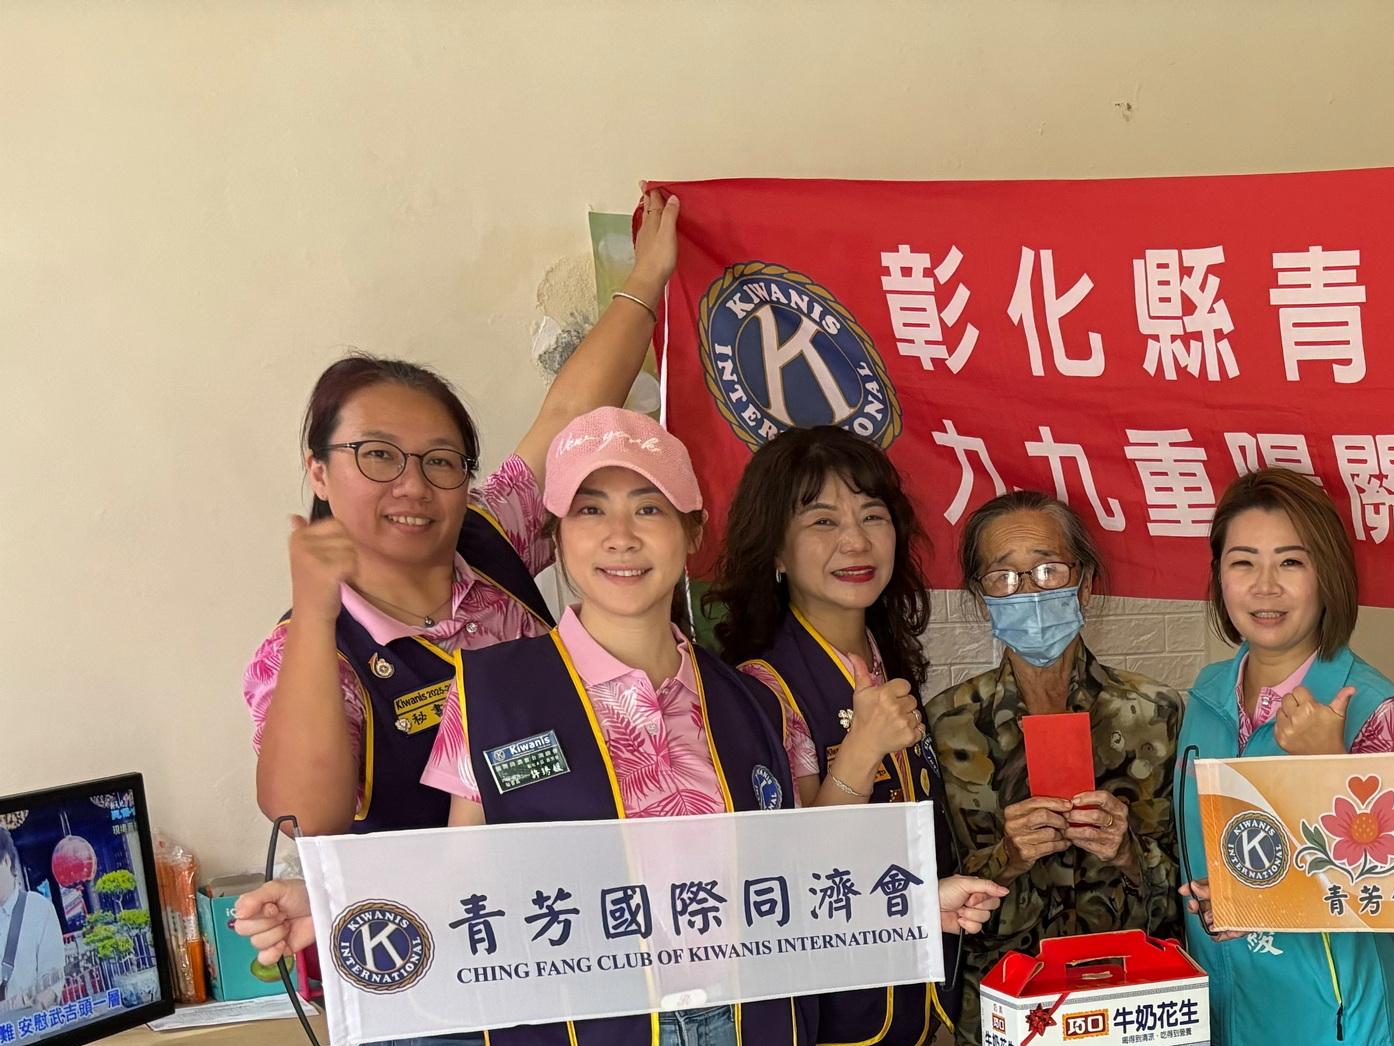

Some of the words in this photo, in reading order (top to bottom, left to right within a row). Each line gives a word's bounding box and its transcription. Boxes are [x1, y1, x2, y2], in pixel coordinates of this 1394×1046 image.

[726, 282, 841, 335] KIWANIS
[715, 343, 886, 441] INTERONAL
[395, 692, 427, 711] Kiwanis
[426, 684, 452, 699] 2025-2
[509, 735, 551, 756] Kiwanis
[1233, 819, 1276, 836] KIWANIS
[1228, 843, 1283, 879] INTERNATIONAL
[347, 910, 410, 932] KIWANIS
[448, 863, 925, 956] 青芳國際同濟會
[340, 936, 422, 983] INTERNATIONAL
[456, 962, 531, 985] CHING
[536, 956, 593, 977] FANG
[597, 949, 653, 971] CLUB
[657, 946, 685, 965] OF
[688, 939, 774, 964] KIWANIS
[777, 924, 930, 955] INTERNATIONAL
[1113, 998, 1200, 1034] 牛奶花生
